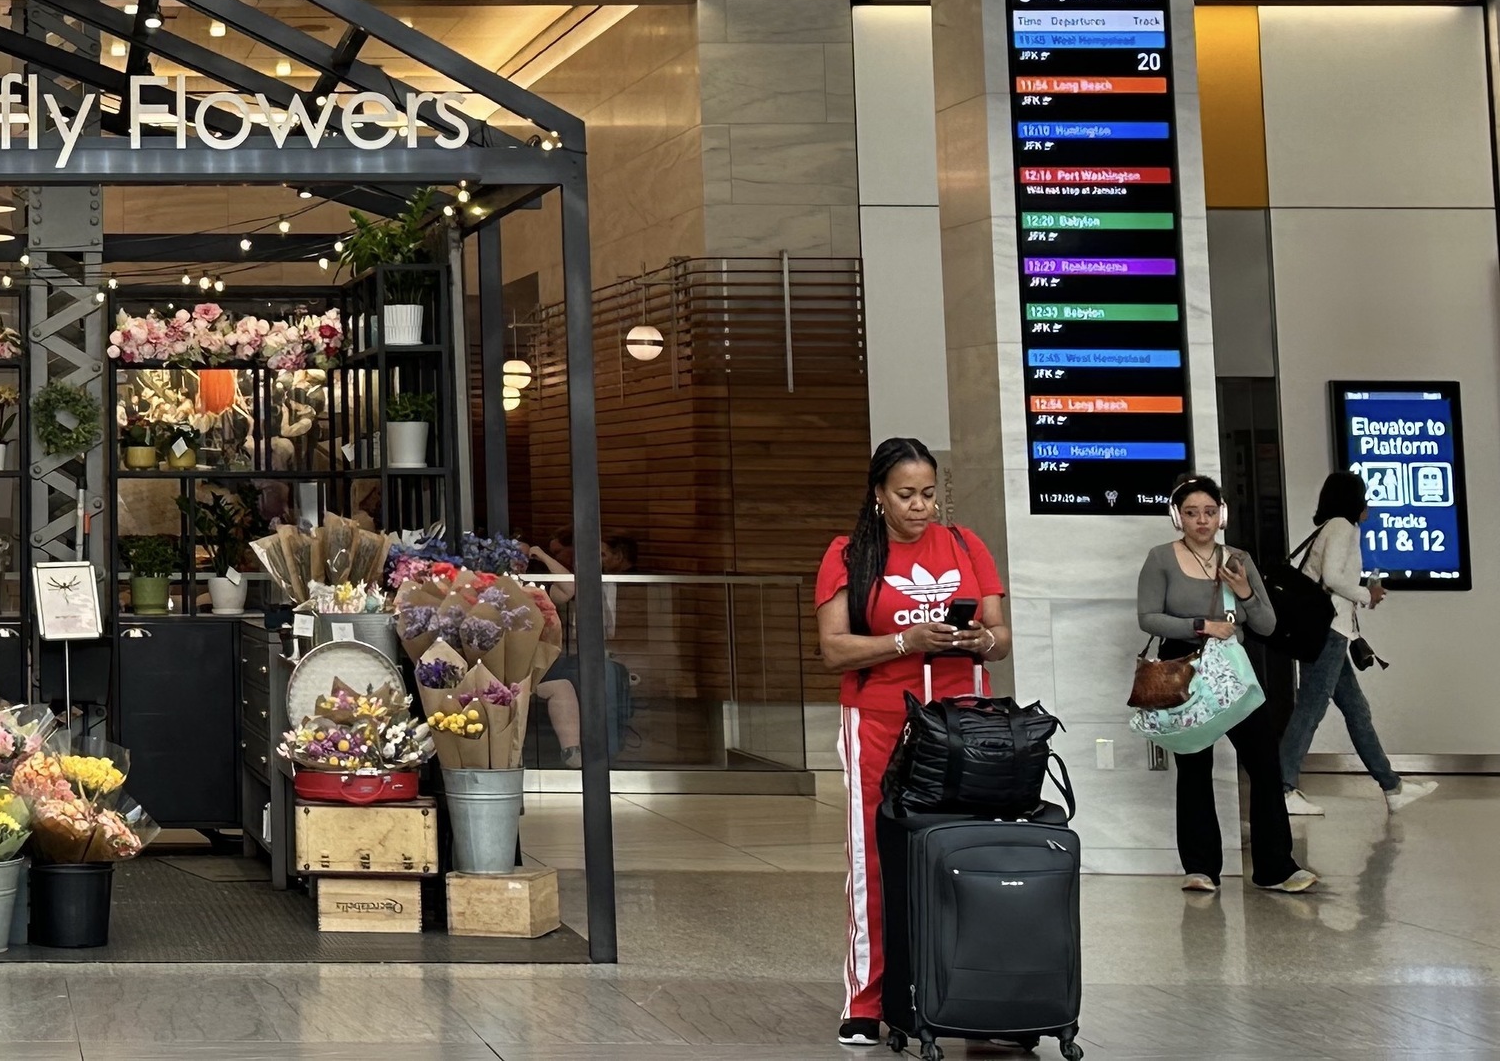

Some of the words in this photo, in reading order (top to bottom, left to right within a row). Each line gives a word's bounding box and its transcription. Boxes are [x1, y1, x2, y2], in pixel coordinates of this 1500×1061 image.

[1018, 16, 1042, 26] Time
[1051, 16, 1106, 27] Departures
[1133, 16, 1160, 26] Track
[1051, 35, 1077, 46] West
[1079, 35, 1136, 47] Hempstead
[1019, 51, 1038, 60] JFK
[1137, 52, 1161, 71] 20
[1053, 80, 1079, 93] Long
[1080, 80, 1112, 90] Beach
[1022, 96, 1041, 105] JFK
[129, 74, 470, 150] Flowers
[1055, 124, 1112, 138] Huntington
[1023, 141, 1042, 150] JFK
[1057, 170, 1079, 181] Port
[1081, 170, 1141, 183] Washington
[1026, 186, 1044, 195] Will
[1045, 186, 1060, 195] not
[1062, 186, 1080, 196] stop
[1081, 186, 1090, 195] at
[1092, 186, 1127, 195] Jamaica
[1027, 216, 1054, 226] 12:20
[1059, 215, 1100, 228] Babylon
[1028, 232, 1046, 241] JFK
[1061, 261, 1128, 272] Ronkonkoma
[1030, 277, 1048, 287] JFK
[1064, 307, 1105, 319] Babylon
[1032, 323, 1051, 332] JFK
[1066, 353, 1091, 363] West
[1093, 353, 1151, 365] Hempstead
[1034, 369, 1052, 379] JFK
[1068, 399, 1094, 412] Long
[1095, 399, 1128, 410] Beach
[1036, 415, 1055, 425] JFK
[1352, 417, 1424, 436] Elevator
[1426, 419, 1445, 436] to
[1070, 445, 1127, 459] Huntington
[1361, 437, 1438, 455] Platform
[1038, 461, 1057, 471] JFK
[1076, 494, 1091, 503] am
[1380, 513, 1427, 528] Tracks
[1365, 530, 1389, 551] 11
[1396, 530, 1414, 551] &
[1419, 530, 1445, 551] 12
